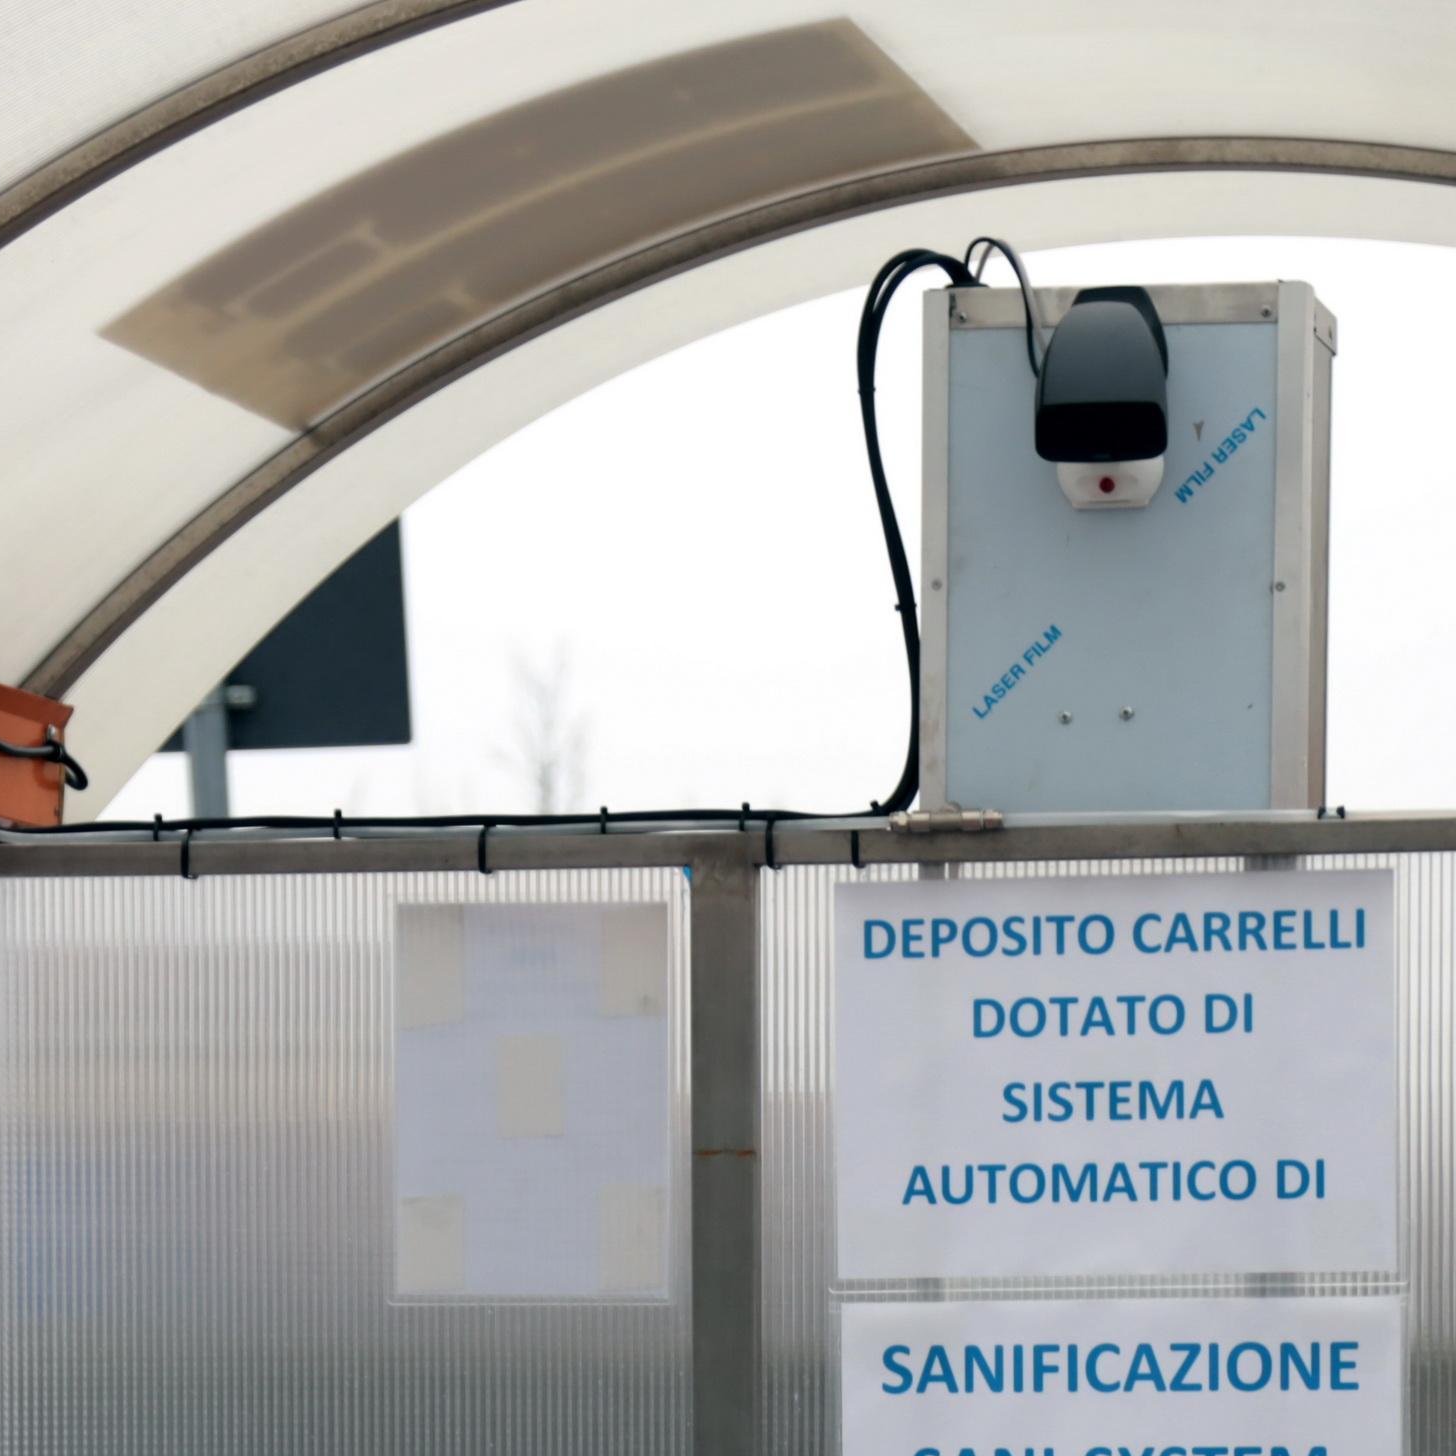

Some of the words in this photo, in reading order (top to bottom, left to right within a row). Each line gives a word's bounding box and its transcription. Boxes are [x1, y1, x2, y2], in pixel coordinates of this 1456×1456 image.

[1211, 407, 1266, 464] LASER
[1174, 461, 1215, 503] FILM
[972, 664, 1026, 719] LASER
[1023, 624, 1062, 666] FILM
[863, 914, 1116, 960] DEPOSITO
[1132, 908, 1366, 954] CARRELLI
[973, 994, 1186, 1038] DOTATO
[1204, 993, 1254, 1034] DI
[1002, 1079, 1225, 1123] SISTEMA
[902, 1160, 1257, 1206] AUTOMATICO
[1275, 1159, 1326, 1199] DI
[881, 1341, 1360, 1395] SANIFICAZIONE
